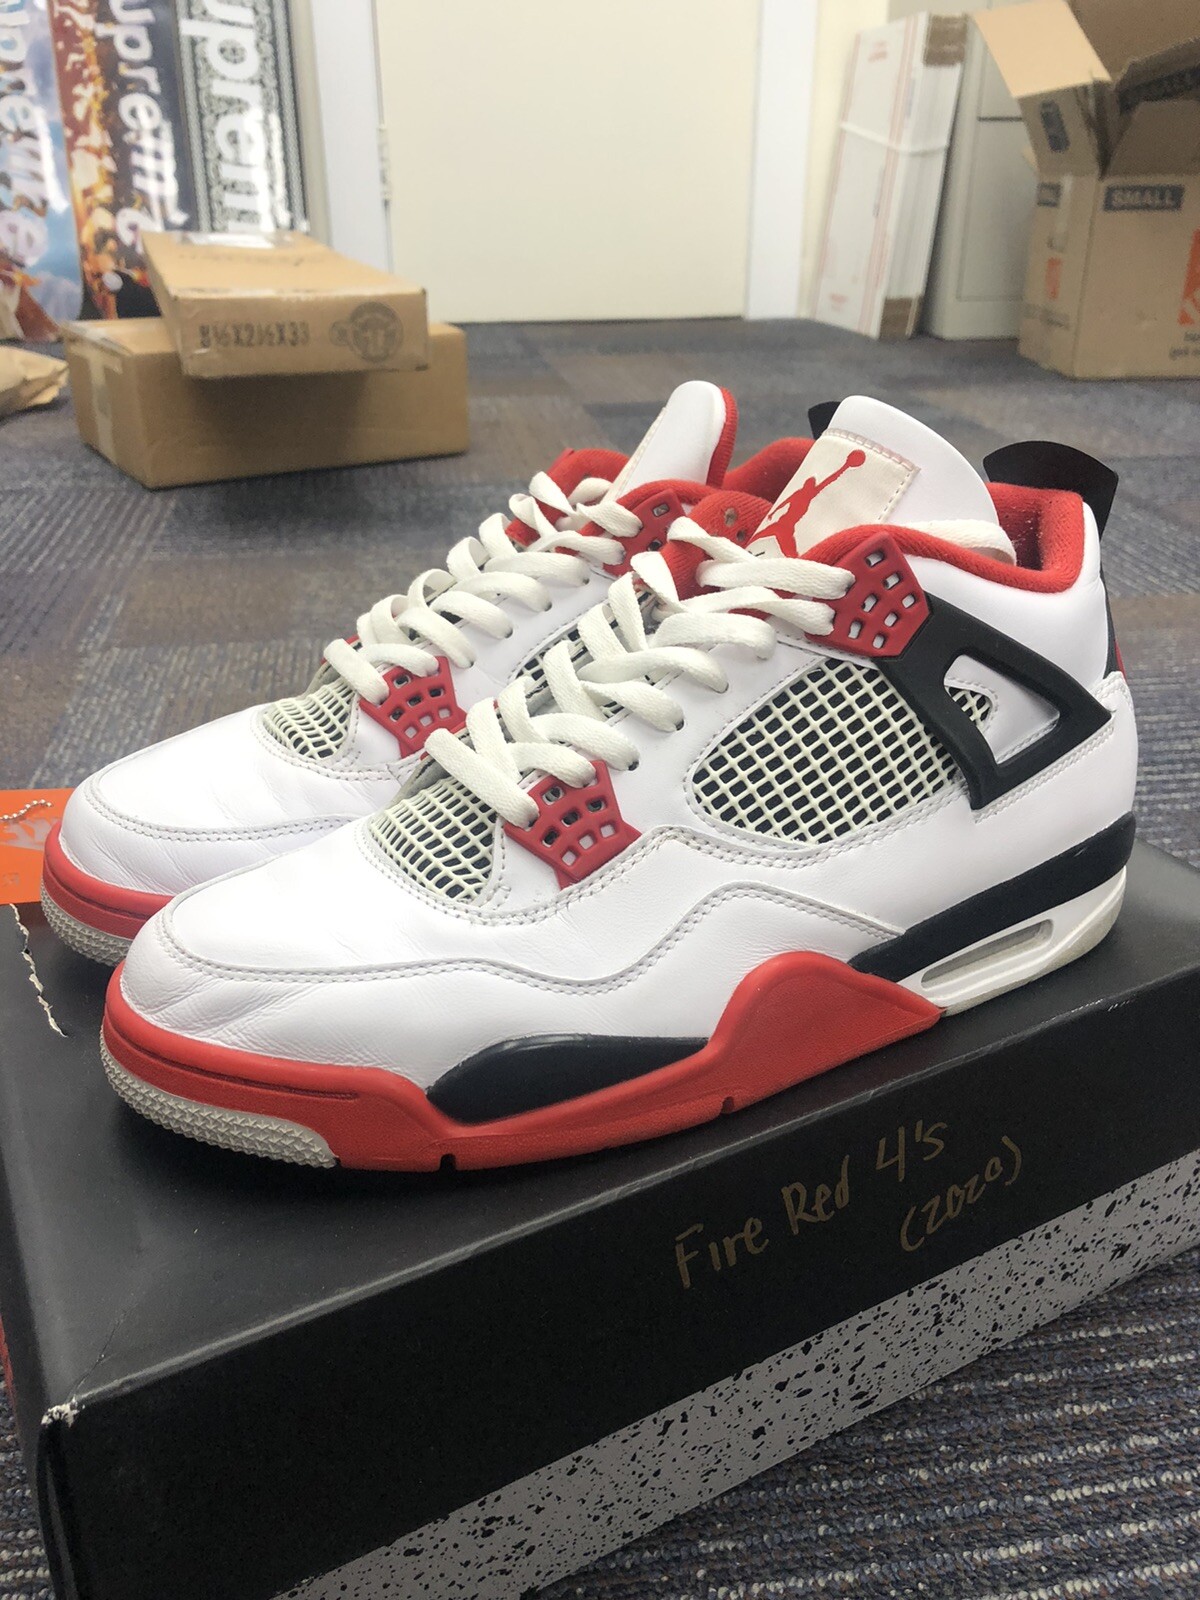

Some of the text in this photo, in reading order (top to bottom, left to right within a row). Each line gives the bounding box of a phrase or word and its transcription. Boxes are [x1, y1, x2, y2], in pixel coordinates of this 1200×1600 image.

[1110, 187, 1177, 207] SMALL
[674, 1119, 948, 1289] Fire Red 4's
[900, 1135, 1022, 1252] (2020)
